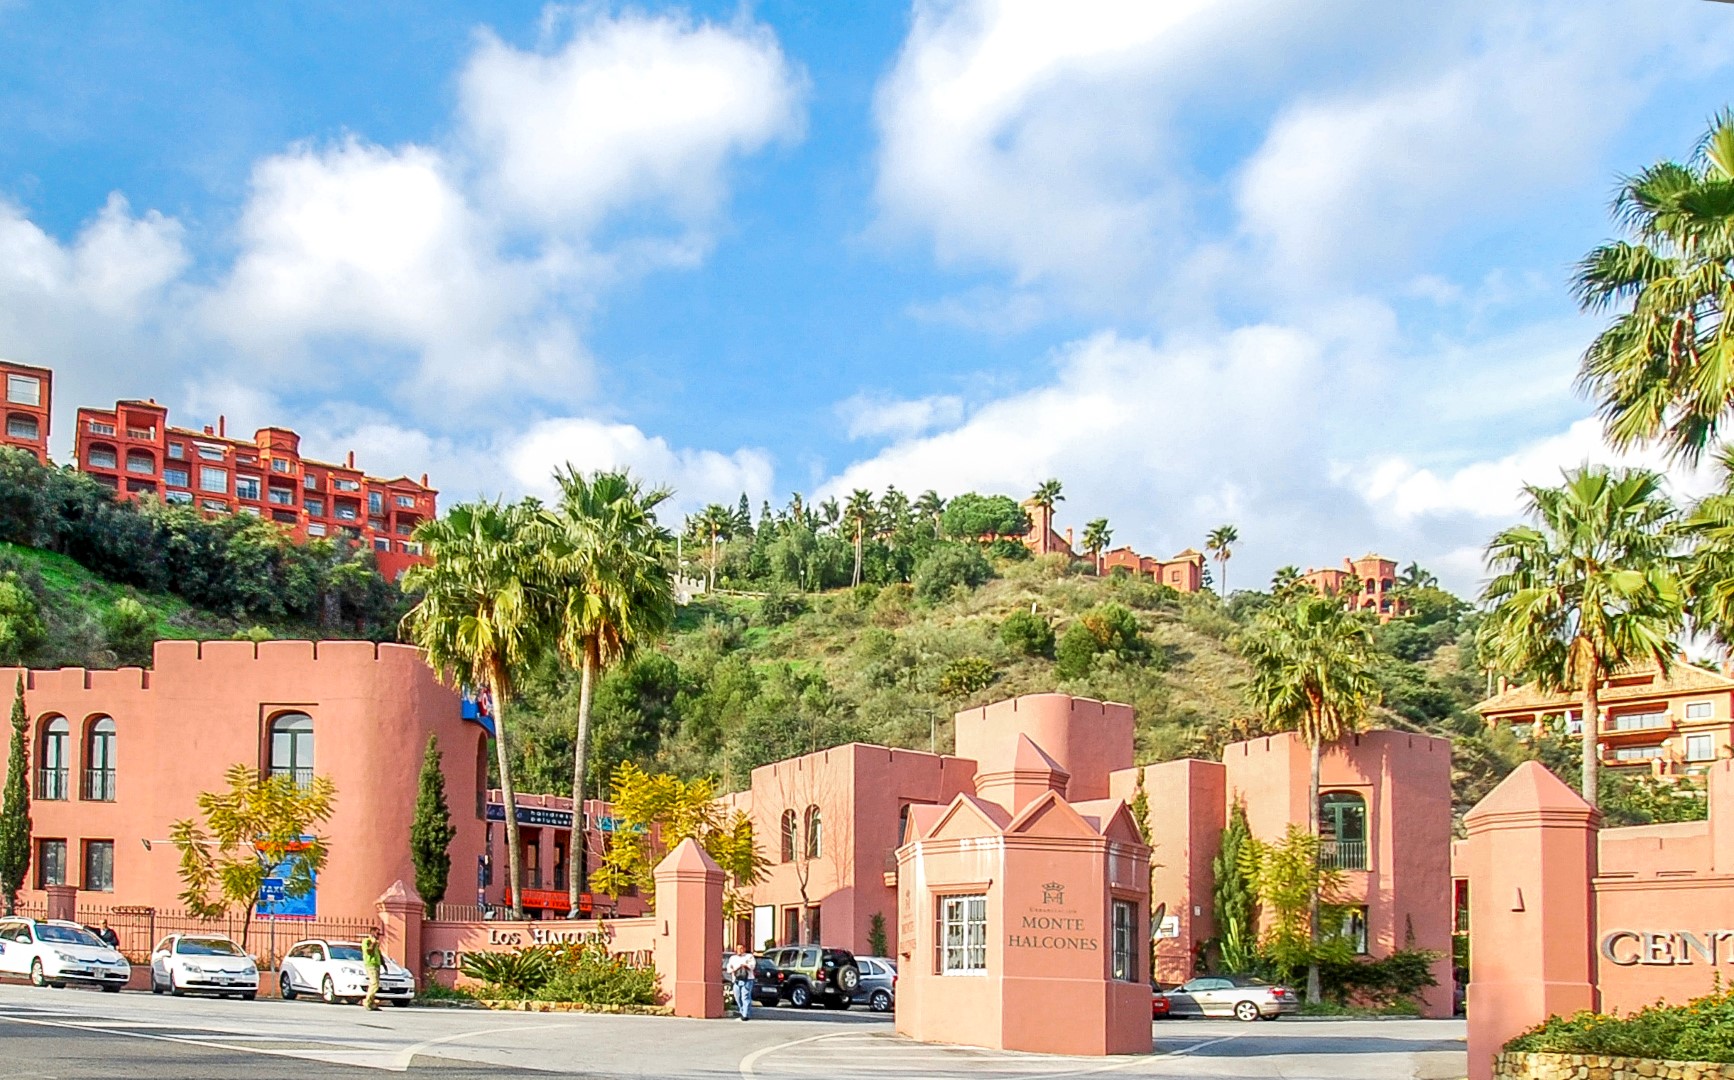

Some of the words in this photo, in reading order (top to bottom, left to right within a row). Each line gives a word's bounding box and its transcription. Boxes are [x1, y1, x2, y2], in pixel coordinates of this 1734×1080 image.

[530, 810, 573, 820] hairdress
[530, 816, 573, 826] peluquer
[261, 885, 284, 893] TAXI
[1021, 916, 1085, 931] MONTE
[488, 928, 521, 945] LOS
[1009, 935, 1098, 951] HALCONES
